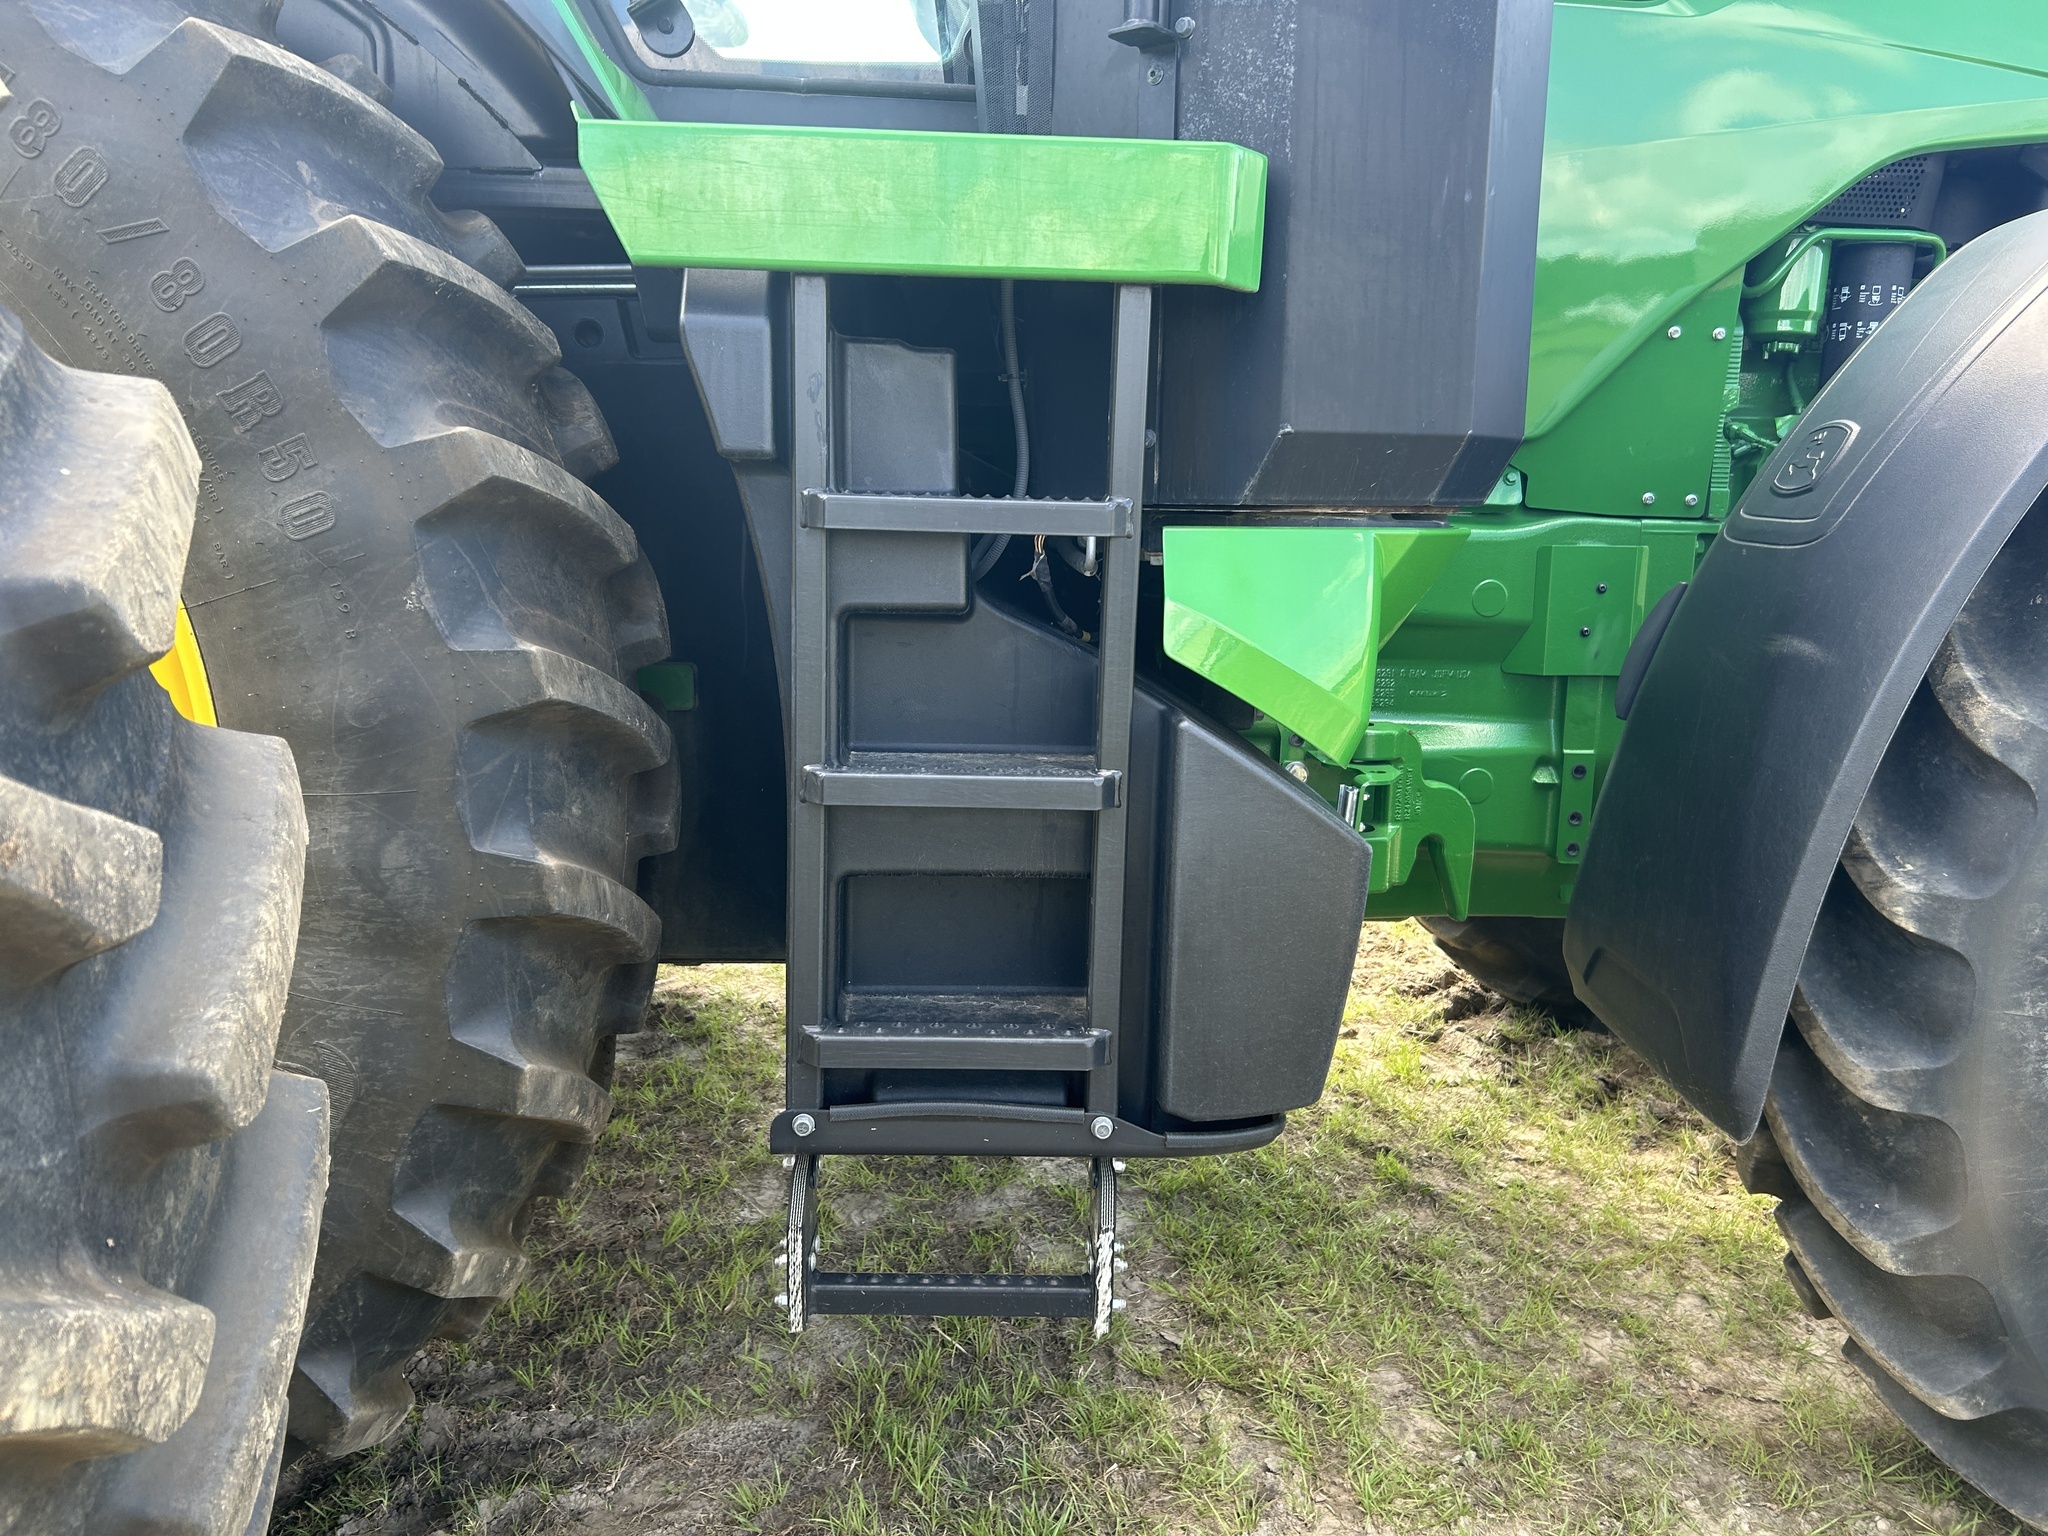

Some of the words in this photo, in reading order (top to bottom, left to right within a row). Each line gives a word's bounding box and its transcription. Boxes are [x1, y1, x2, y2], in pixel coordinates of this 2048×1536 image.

[0, 62, 335, 540] 80/80R50
[53, 265, 76, 293] MAX
[78, 293, 105, 327] LOAD
[104, 328, 120, 345] AT
[84, 276, 128, 333] TRACTOR
[127, 332, 156, 375] DRIVE
[189, 426, 227, 484] SERVICE
